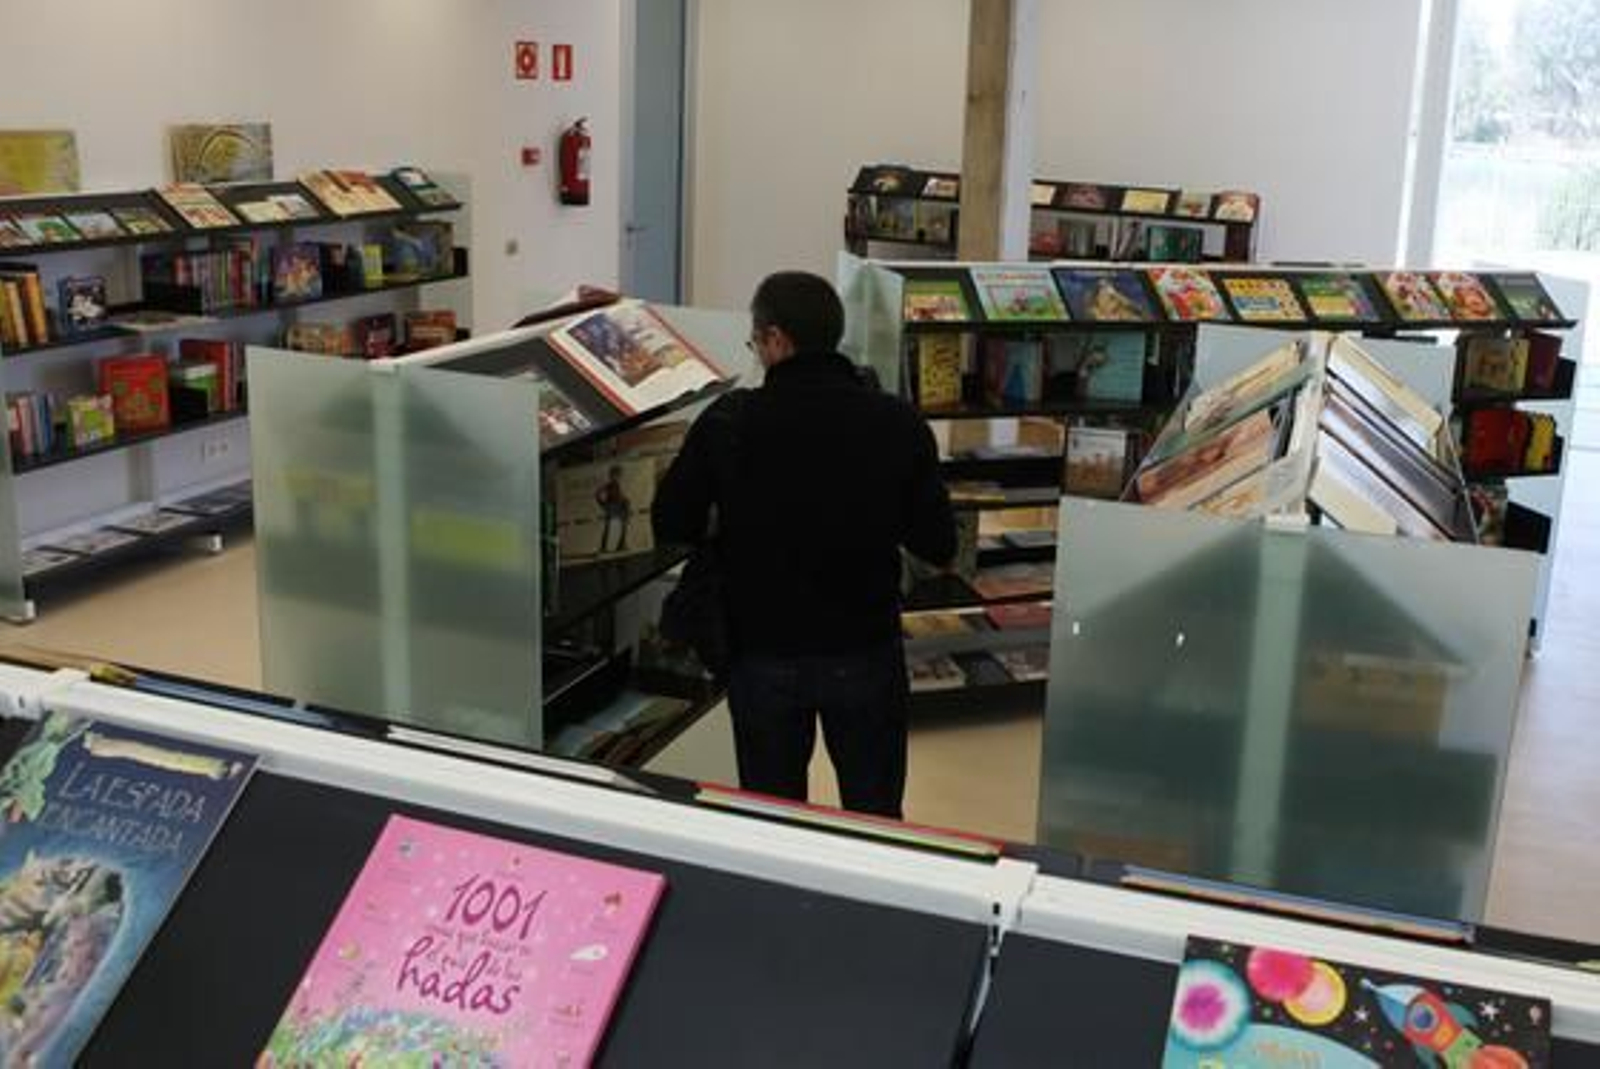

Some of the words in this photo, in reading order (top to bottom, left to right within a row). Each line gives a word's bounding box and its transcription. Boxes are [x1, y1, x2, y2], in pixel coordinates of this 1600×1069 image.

[58, 761, 105, 801] LA
[104, 777, 206, 823] ESPADA
[445, 873, 547, 939] 1001
[397, 935, 520, 1014] hadas
